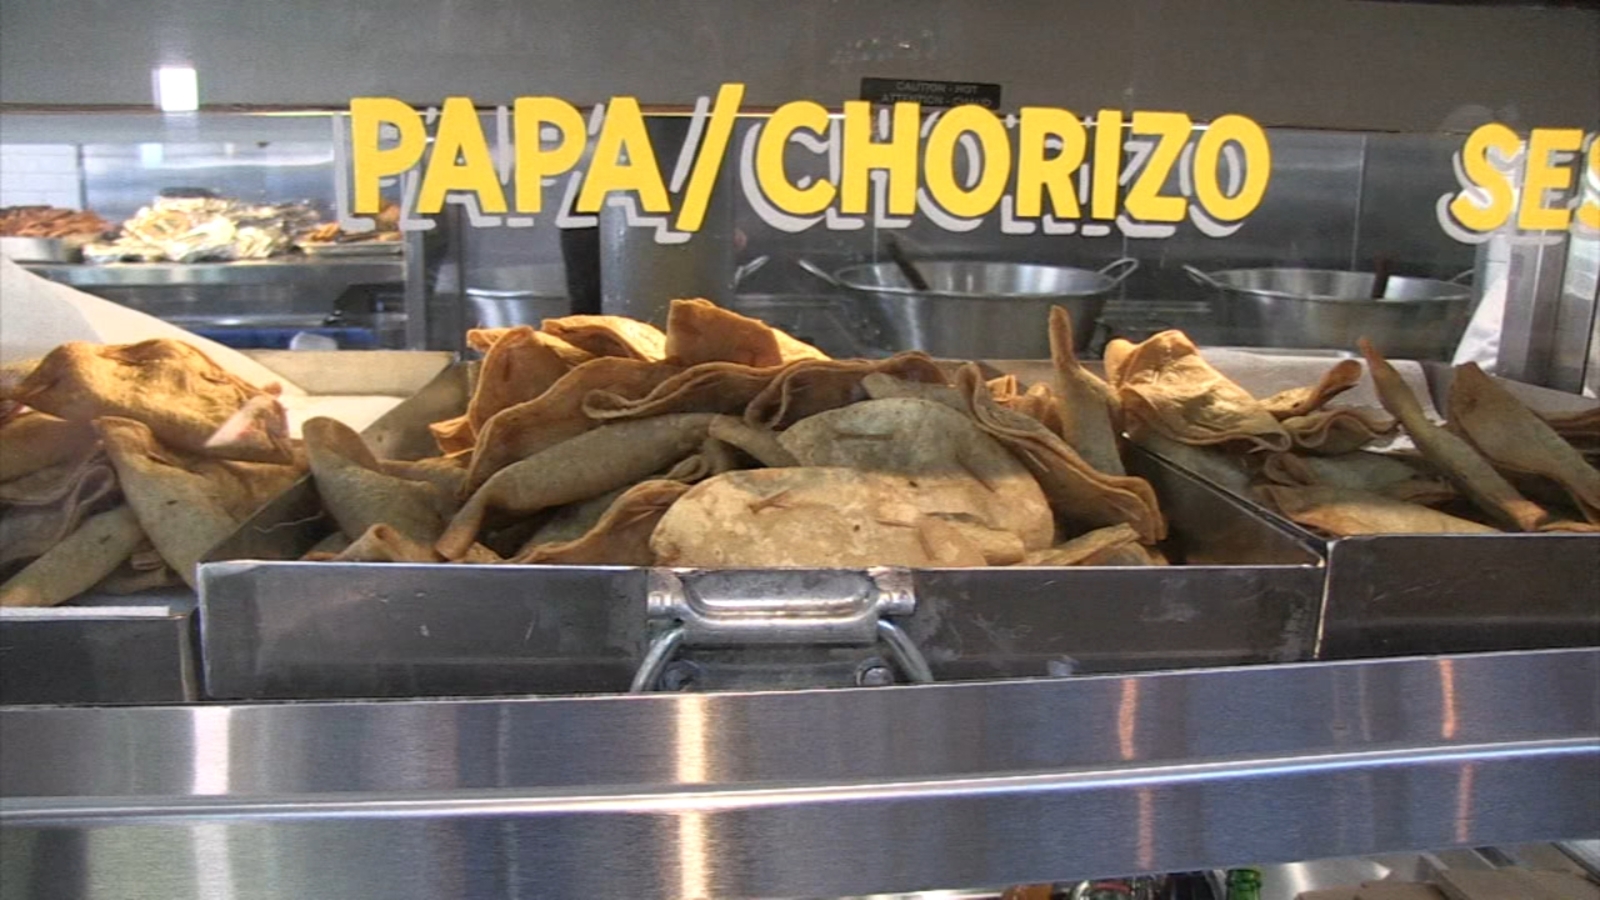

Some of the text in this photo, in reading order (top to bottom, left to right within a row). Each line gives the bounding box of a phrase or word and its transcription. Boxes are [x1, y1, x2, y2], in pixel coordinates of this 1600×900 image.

[896, 80, 946, 93] CAUTION
[954, 84, 979, 95] HOT
[350, 84, 1271, 231] PAPA/CHORIZO
